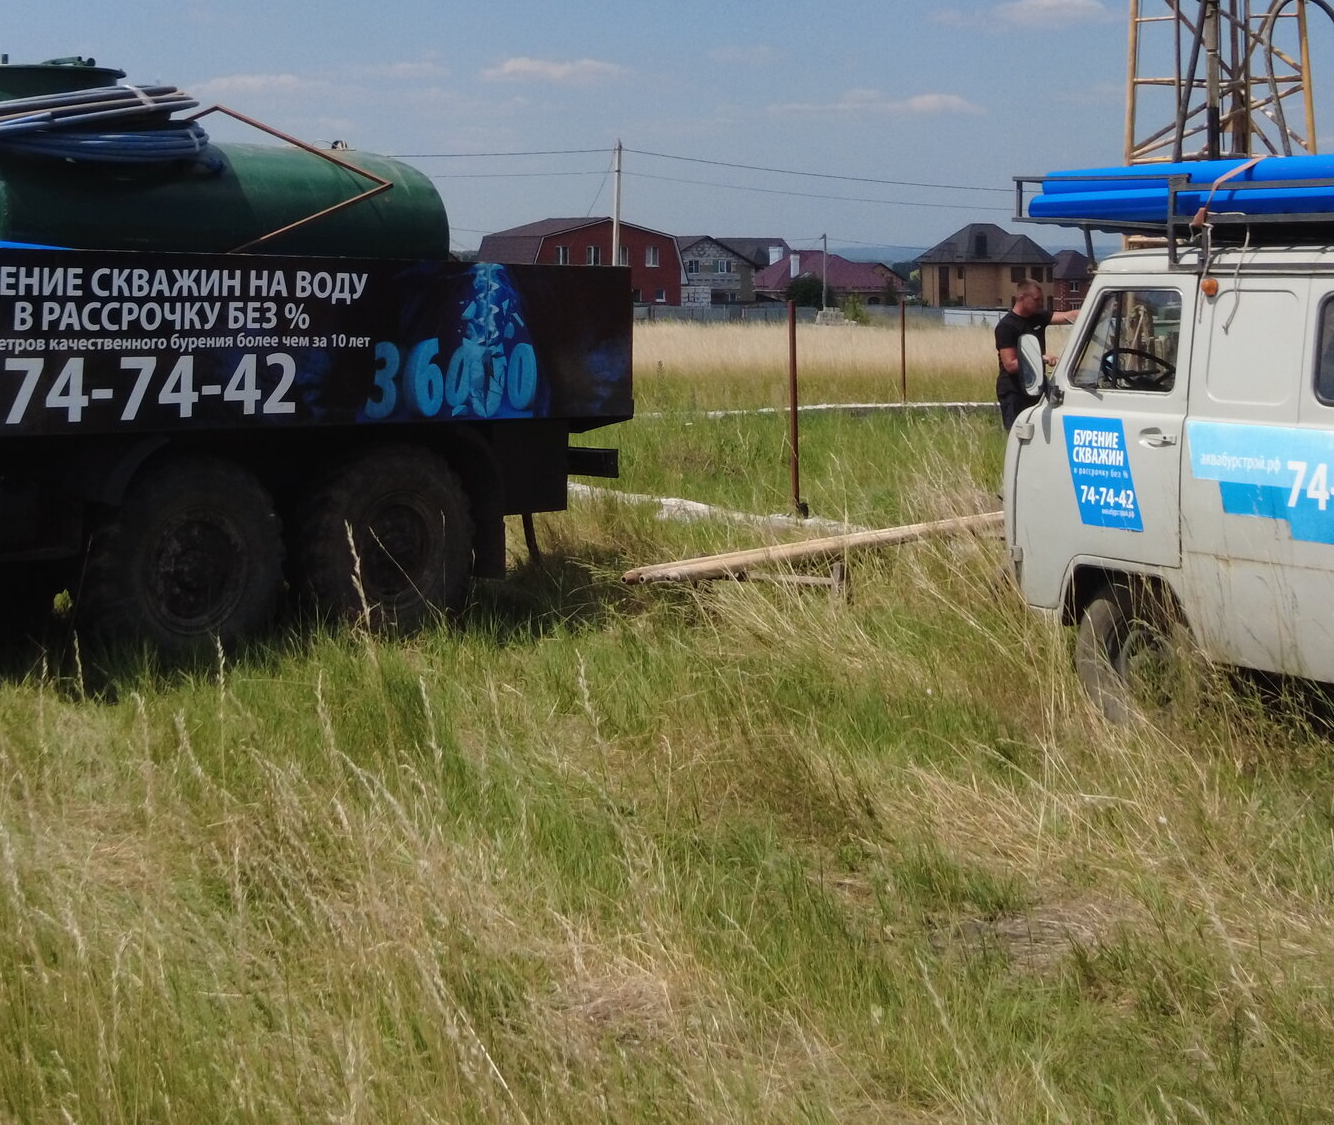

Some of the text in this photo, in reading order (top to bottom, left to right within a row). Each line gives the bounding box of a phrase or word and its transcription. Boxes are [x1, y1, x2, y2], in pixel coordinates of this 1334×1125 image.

[91, 268, 241, 297] СКВАЖИН
[249, 270, 288, 297] НА
[295, 271, 368, 305] ВОДУ
[14, 301, 310, 331] В РАССРОЧКУ БЕЗ %
[49, 338, 167, 351] качественного
[170, 334, 233, 352] бурения
[236, 332, 279, 348] более
[282, 335, 310, 347] чем
[312, 336, 327, 348] за
[331, 334, 346, 348] 10
[348, 336, 370, 348] лет
[3, 352, 297, 425] 74-74-42
[1073, 429, 1119, 449] БУРЕНИЕ
[1072, 446, 1124, 466] СКВАЖИН
[1080, 484, 1134, 509] 74-74-42
